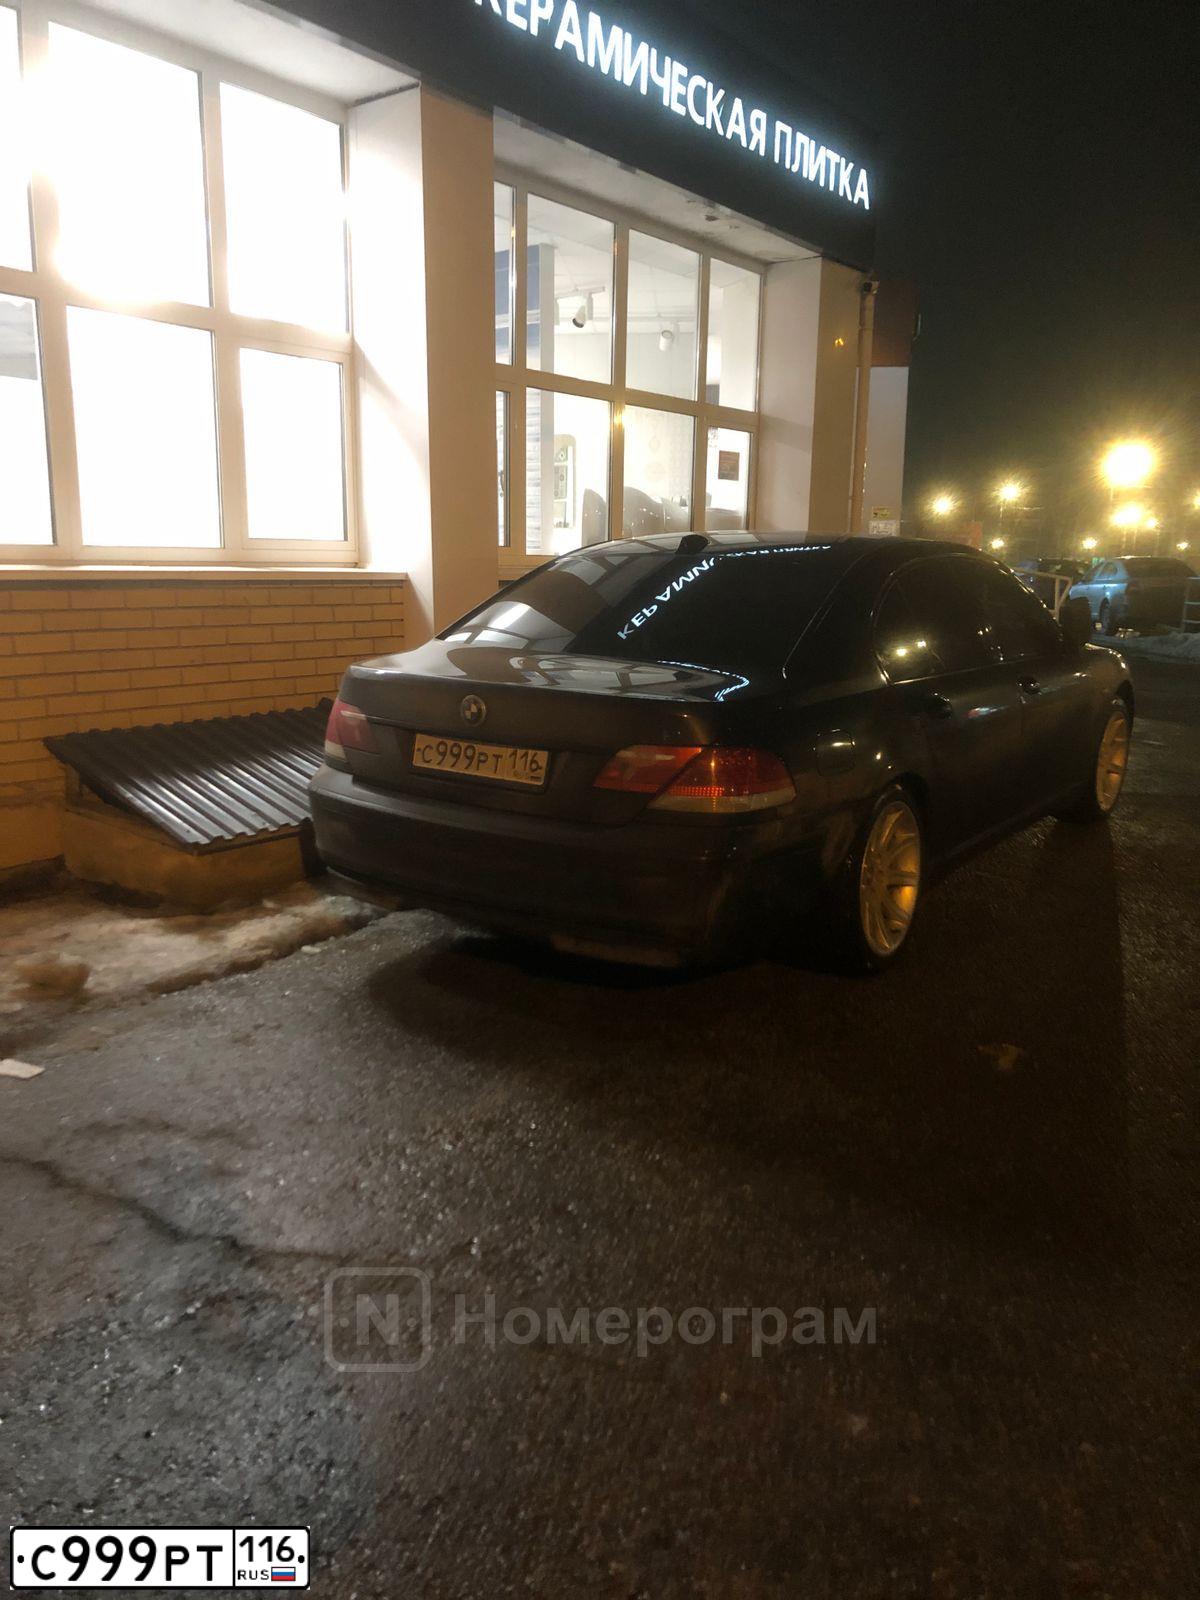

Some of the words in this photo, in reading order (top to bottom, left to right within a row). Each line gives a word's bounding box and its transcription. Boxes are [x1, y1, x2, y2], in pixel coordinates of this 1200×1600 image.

[474, 0, 767, 157] ЕРАМИЧЕСКАЯ
[774, 120, 870, 210] ПЛИТКА
[421, 741, 503, 774] С999РТ
[508, 749, 541, 772] 116
